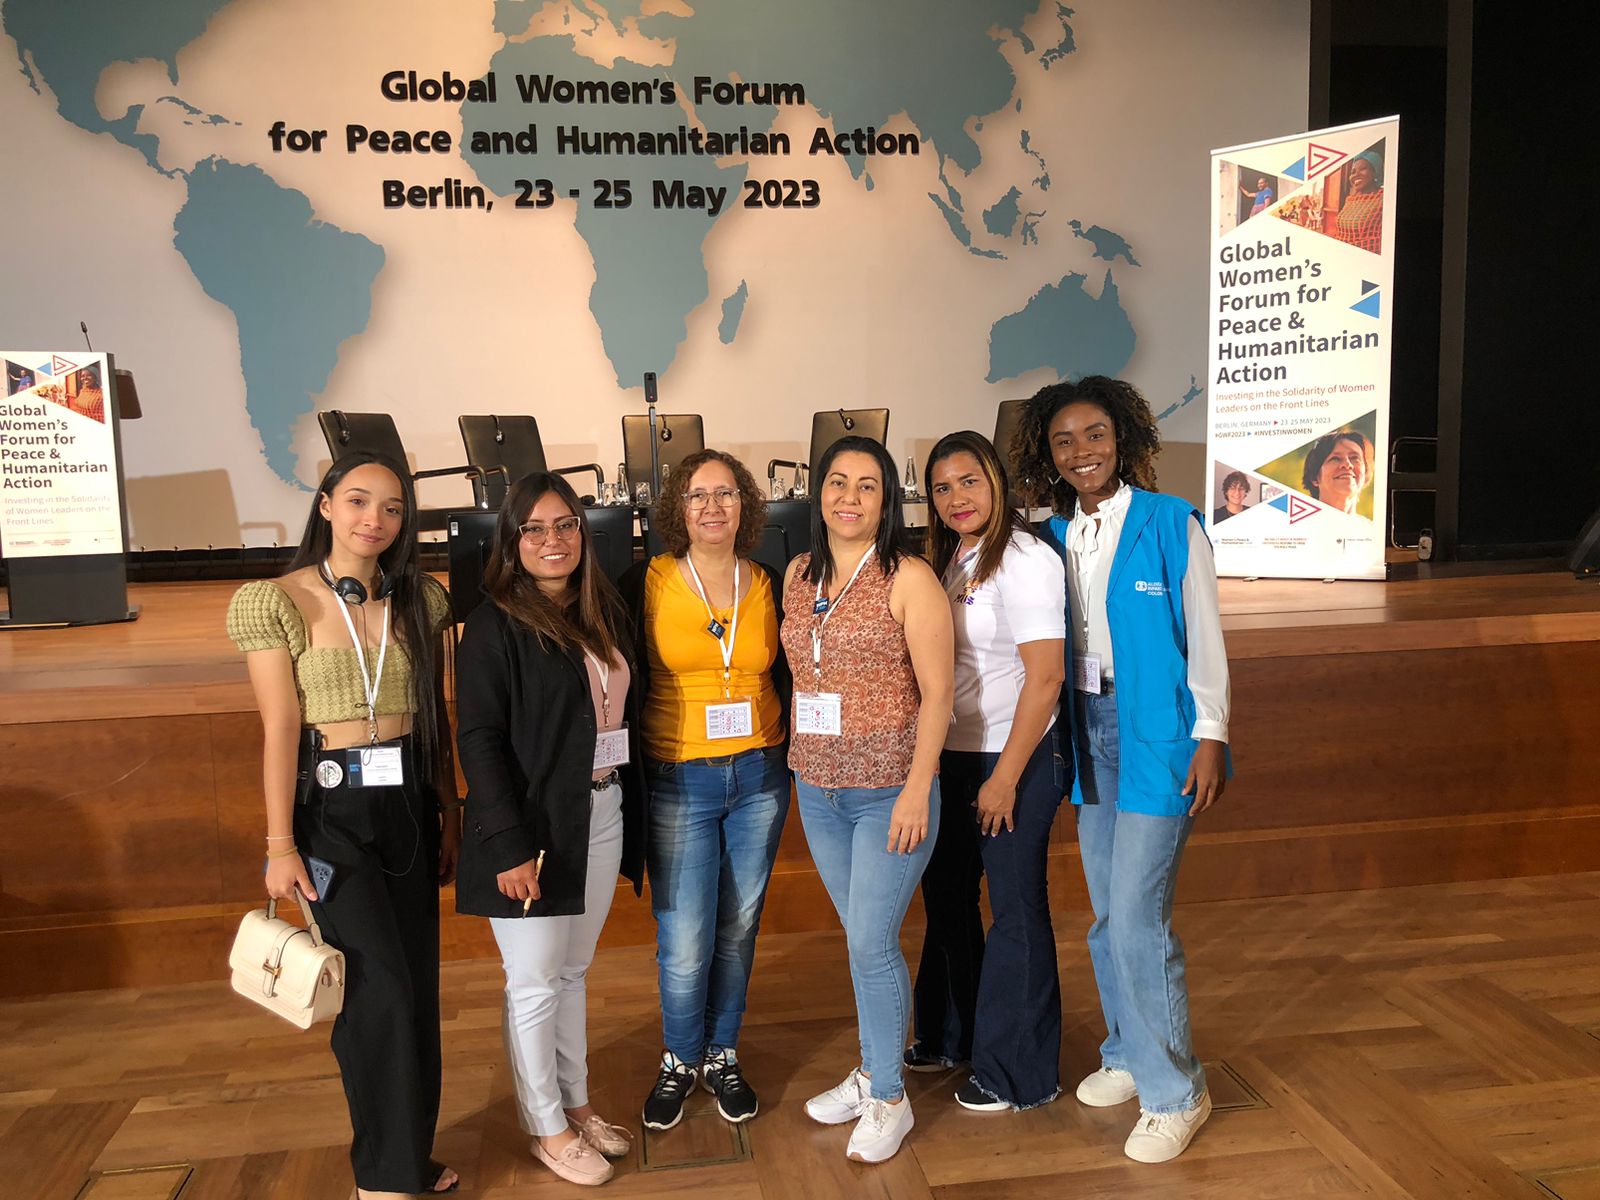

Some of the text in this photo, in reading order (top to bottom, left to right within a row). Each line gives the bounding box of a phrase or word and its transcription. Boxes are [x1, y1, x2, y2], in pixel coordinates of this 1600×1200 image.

[380, 71, 805, 106] Global Women’s Forum
[268, 121, 920, 156] for Peace and Humanitarian Action
[382, 180, 493, 212] Berlin,
[514, 180, 554, 208] 23
[594, 180, 632, 208] 25
[653, 180, 726, 216] May
[743, 179, 821, 208] 2023
[1220, 236, 1291, 264] Global
[1219, 259, 1322, 288] Women’s
[1219, 283, 1332, 312] Forum for
[1218, 310, 1305, 337] Peace &
[1218, 330, 1380, 360] Humanitarian
[1216, 362, 1287, 384] Action
[1216, 384, 1375, 401] Investing in the Solidarity of Women
[0, 404, 47, 416] Global
[1215, 398, 1330, 414] Leaders on the Front Lines
[0, 419, 68, 431] Women’s
[1240, 421, 1272, 429] GERMANY
[1299, 417, 1314, 425] MAY
[1315, 417, 1331, 425] 2023
[0, 433, 76, 445] Forum for
[1254, 427, 1313, 437] #INVESTINWOMEN
[1, 448, 61, 460] Peace &
[2, 461, 108, 474] Humanitarian
[3, 476, 52, 489] Action
